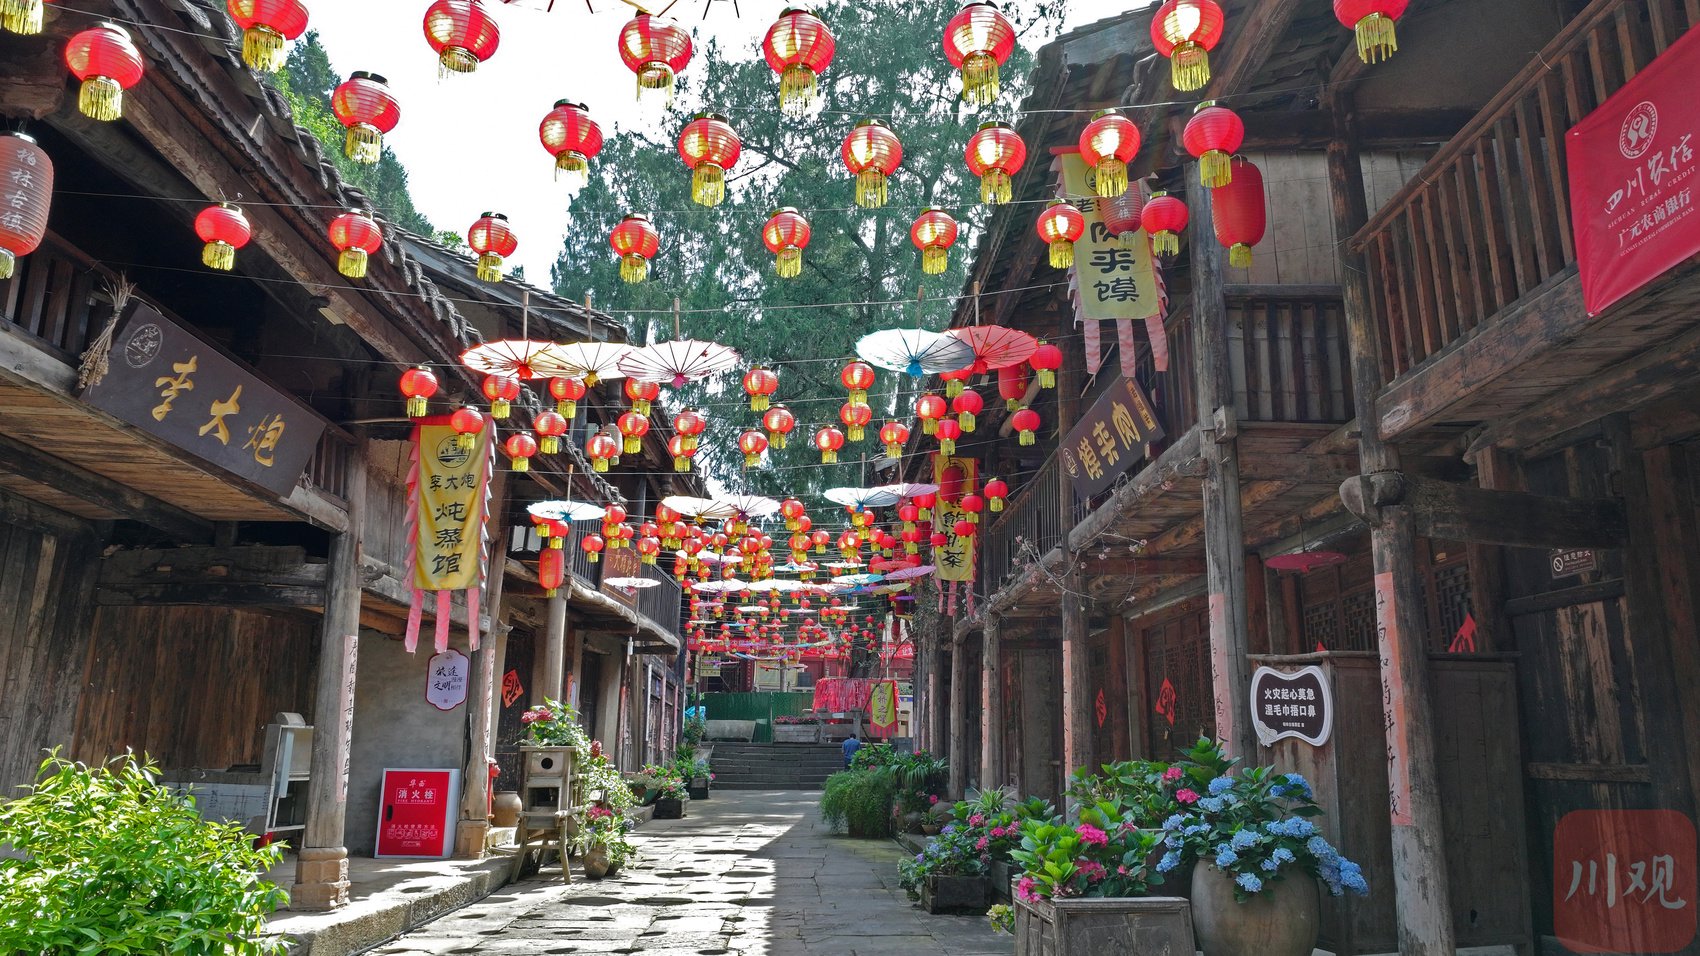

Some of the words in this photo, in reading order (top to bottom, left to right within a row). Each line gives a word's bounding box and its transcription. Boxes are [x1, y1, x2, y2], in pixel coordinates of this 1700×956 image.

[1604, 133, 1694, 214] 四川农信
[1607, 208, 1636, 229] SICHUAN
[1641, 189, 1662, 207] RURAL
[1667, 165, 1696, 188] CREDIT
[1618, 187, 1691, 248] 广元农商银行
[152, 355, 286, 467] 李大炮
[429, 474, 476, 492] 李大炮
[432, 501, 466, 576] 炖蒸馆
[1264, 688, 1316, 700] 火灾起心莫急
[1265, 704, 1316, 717] 湿毛巾捂口鼻
[398, 789, 434, 799] 消火栓
